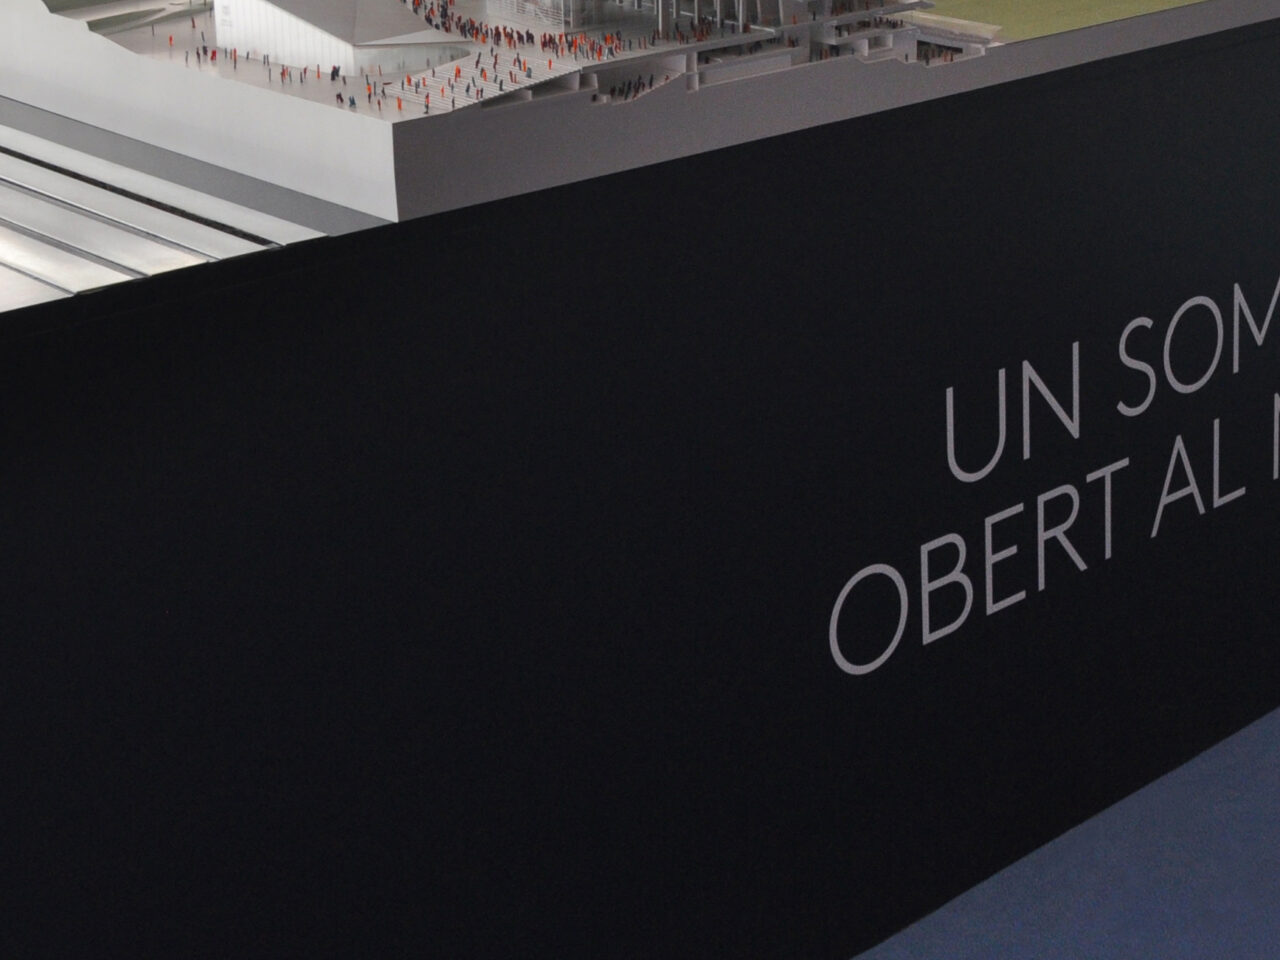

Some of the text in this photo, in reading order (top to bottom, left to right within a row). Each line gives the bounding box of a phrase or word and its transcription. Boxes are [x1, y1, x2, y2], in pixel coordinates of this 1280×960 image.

[945, 341, 1080, 483] UN
[828, 456, 1130, 676] OBERT
[1150, 417, 1247, 539] AL
